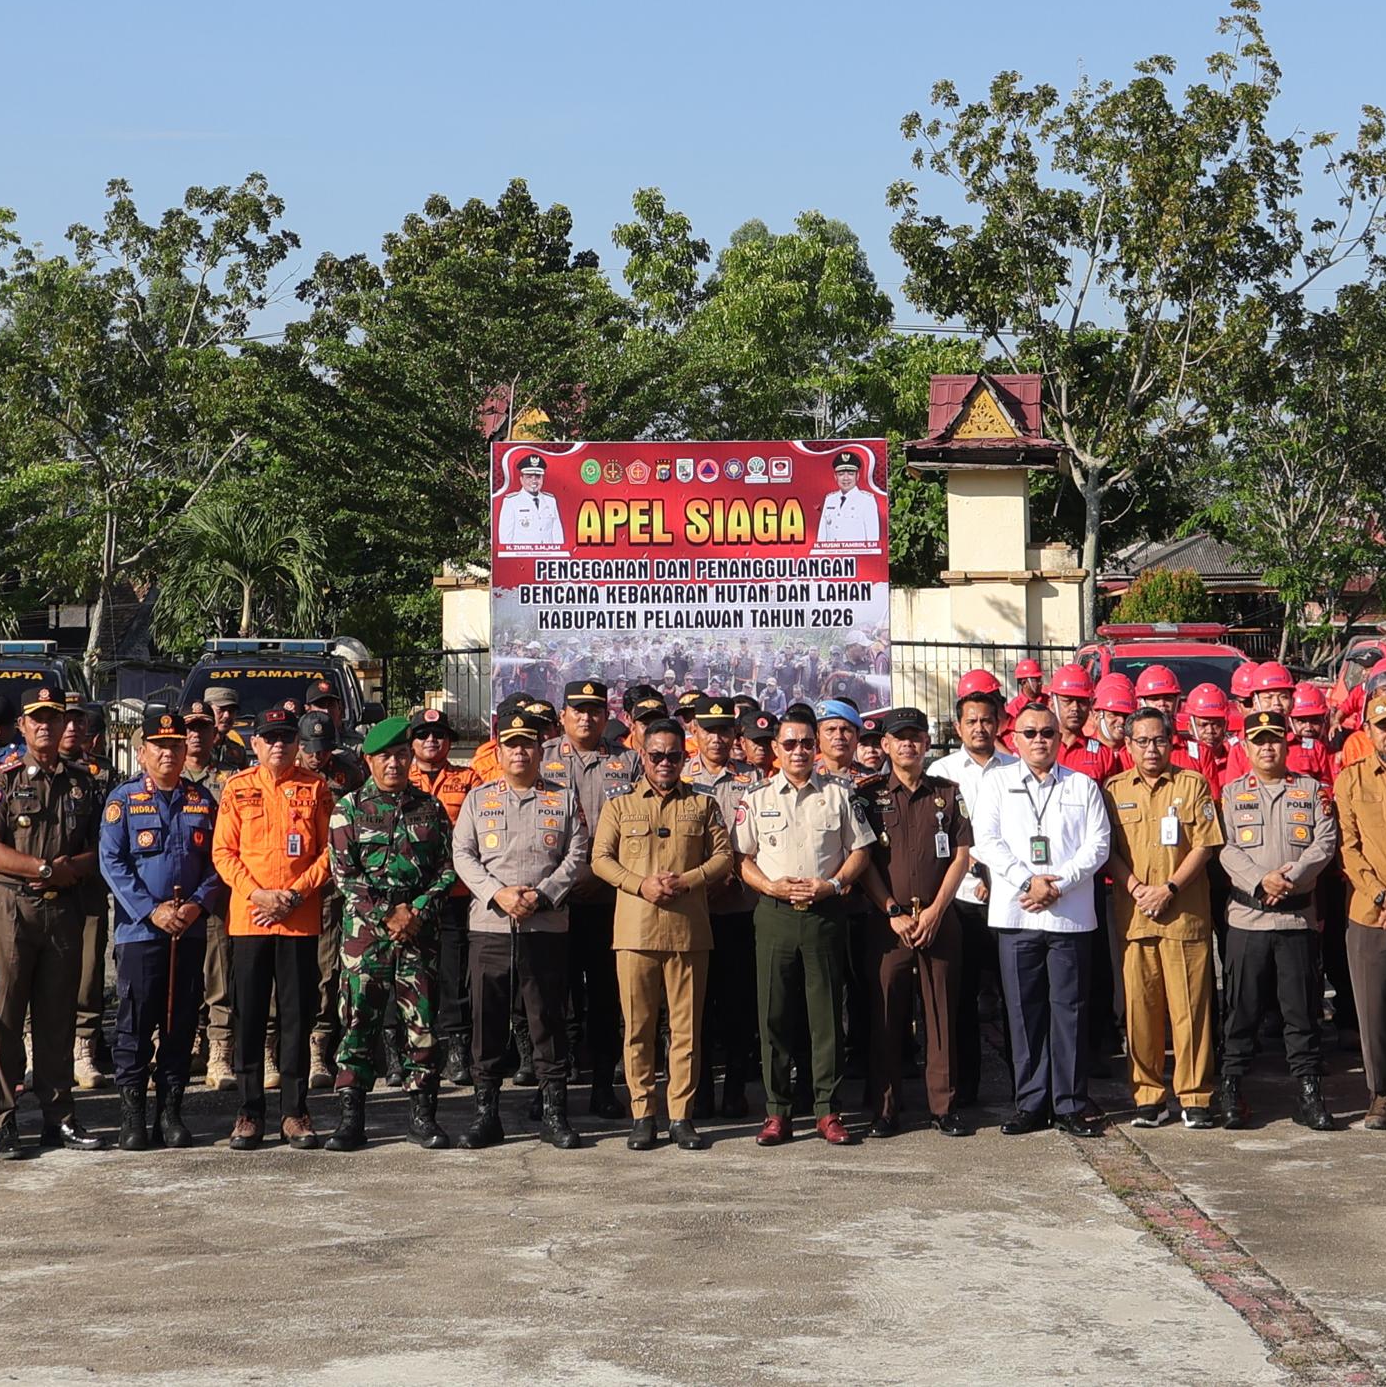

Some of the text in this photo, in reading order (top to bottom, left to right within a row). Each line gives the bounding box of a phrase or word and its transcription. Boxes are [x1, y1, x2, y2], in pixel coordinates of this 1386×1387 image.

[577, 498, 805, 545] APEL SIAGA
[536, 559, 856, 580] PENCEGAHAN DAN PENANGGULANGAN
[520, 582, 871, 604] BENCANA KEBAKARAN HUTAN DAN LAHAN
[539, 608, 854, 629] KABUPATEN PELALAWAN TAHUN 2026
[210, 670, 325, 680] SAT SAMAPTA
[129, 805, 157, 814] INDRA
[1286, 801, 1312, 809] POLRI
[479, 809, 505, 817] JOHN
[538, 809, 565, 817] POLRI
